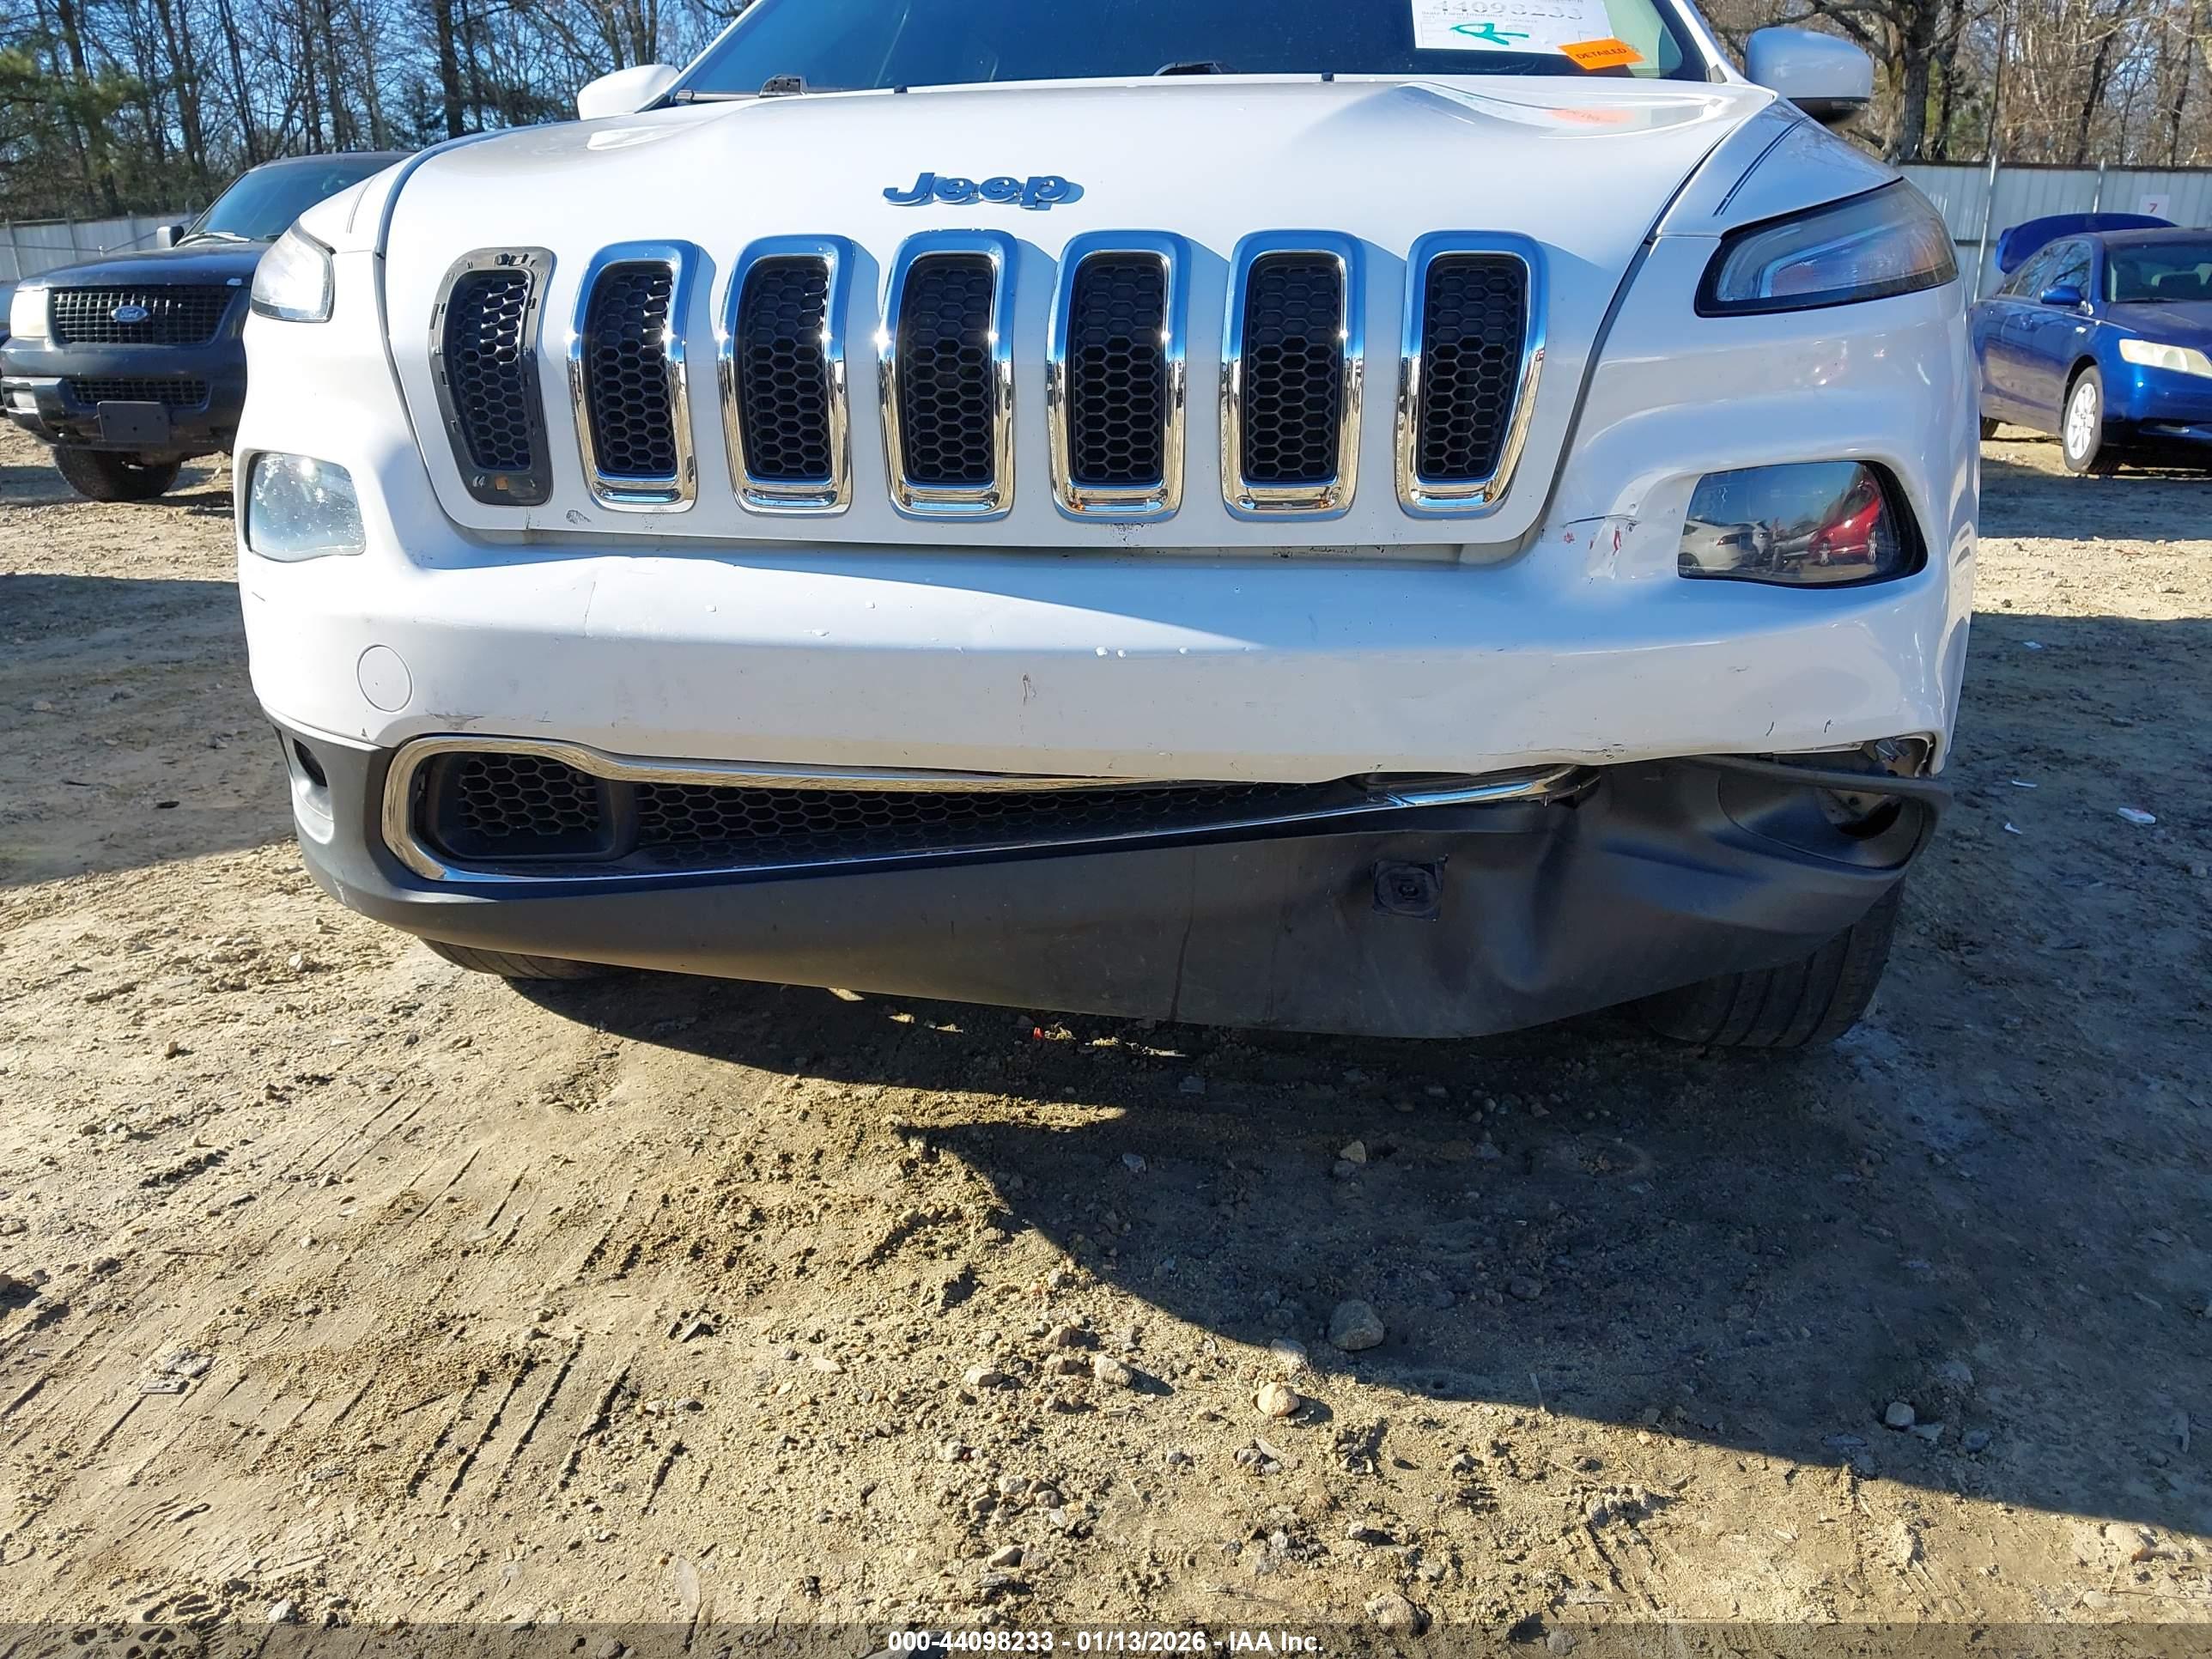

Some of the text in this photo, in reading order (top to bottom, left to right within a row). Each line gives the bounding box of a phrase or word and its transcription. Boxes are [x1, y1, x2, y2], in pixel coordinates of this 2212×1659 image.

[1576, 47, 1627, 59] DETAILED
[883, 172, 1069, 209] Jeep
[2149, 203, 2158, 214] 7
